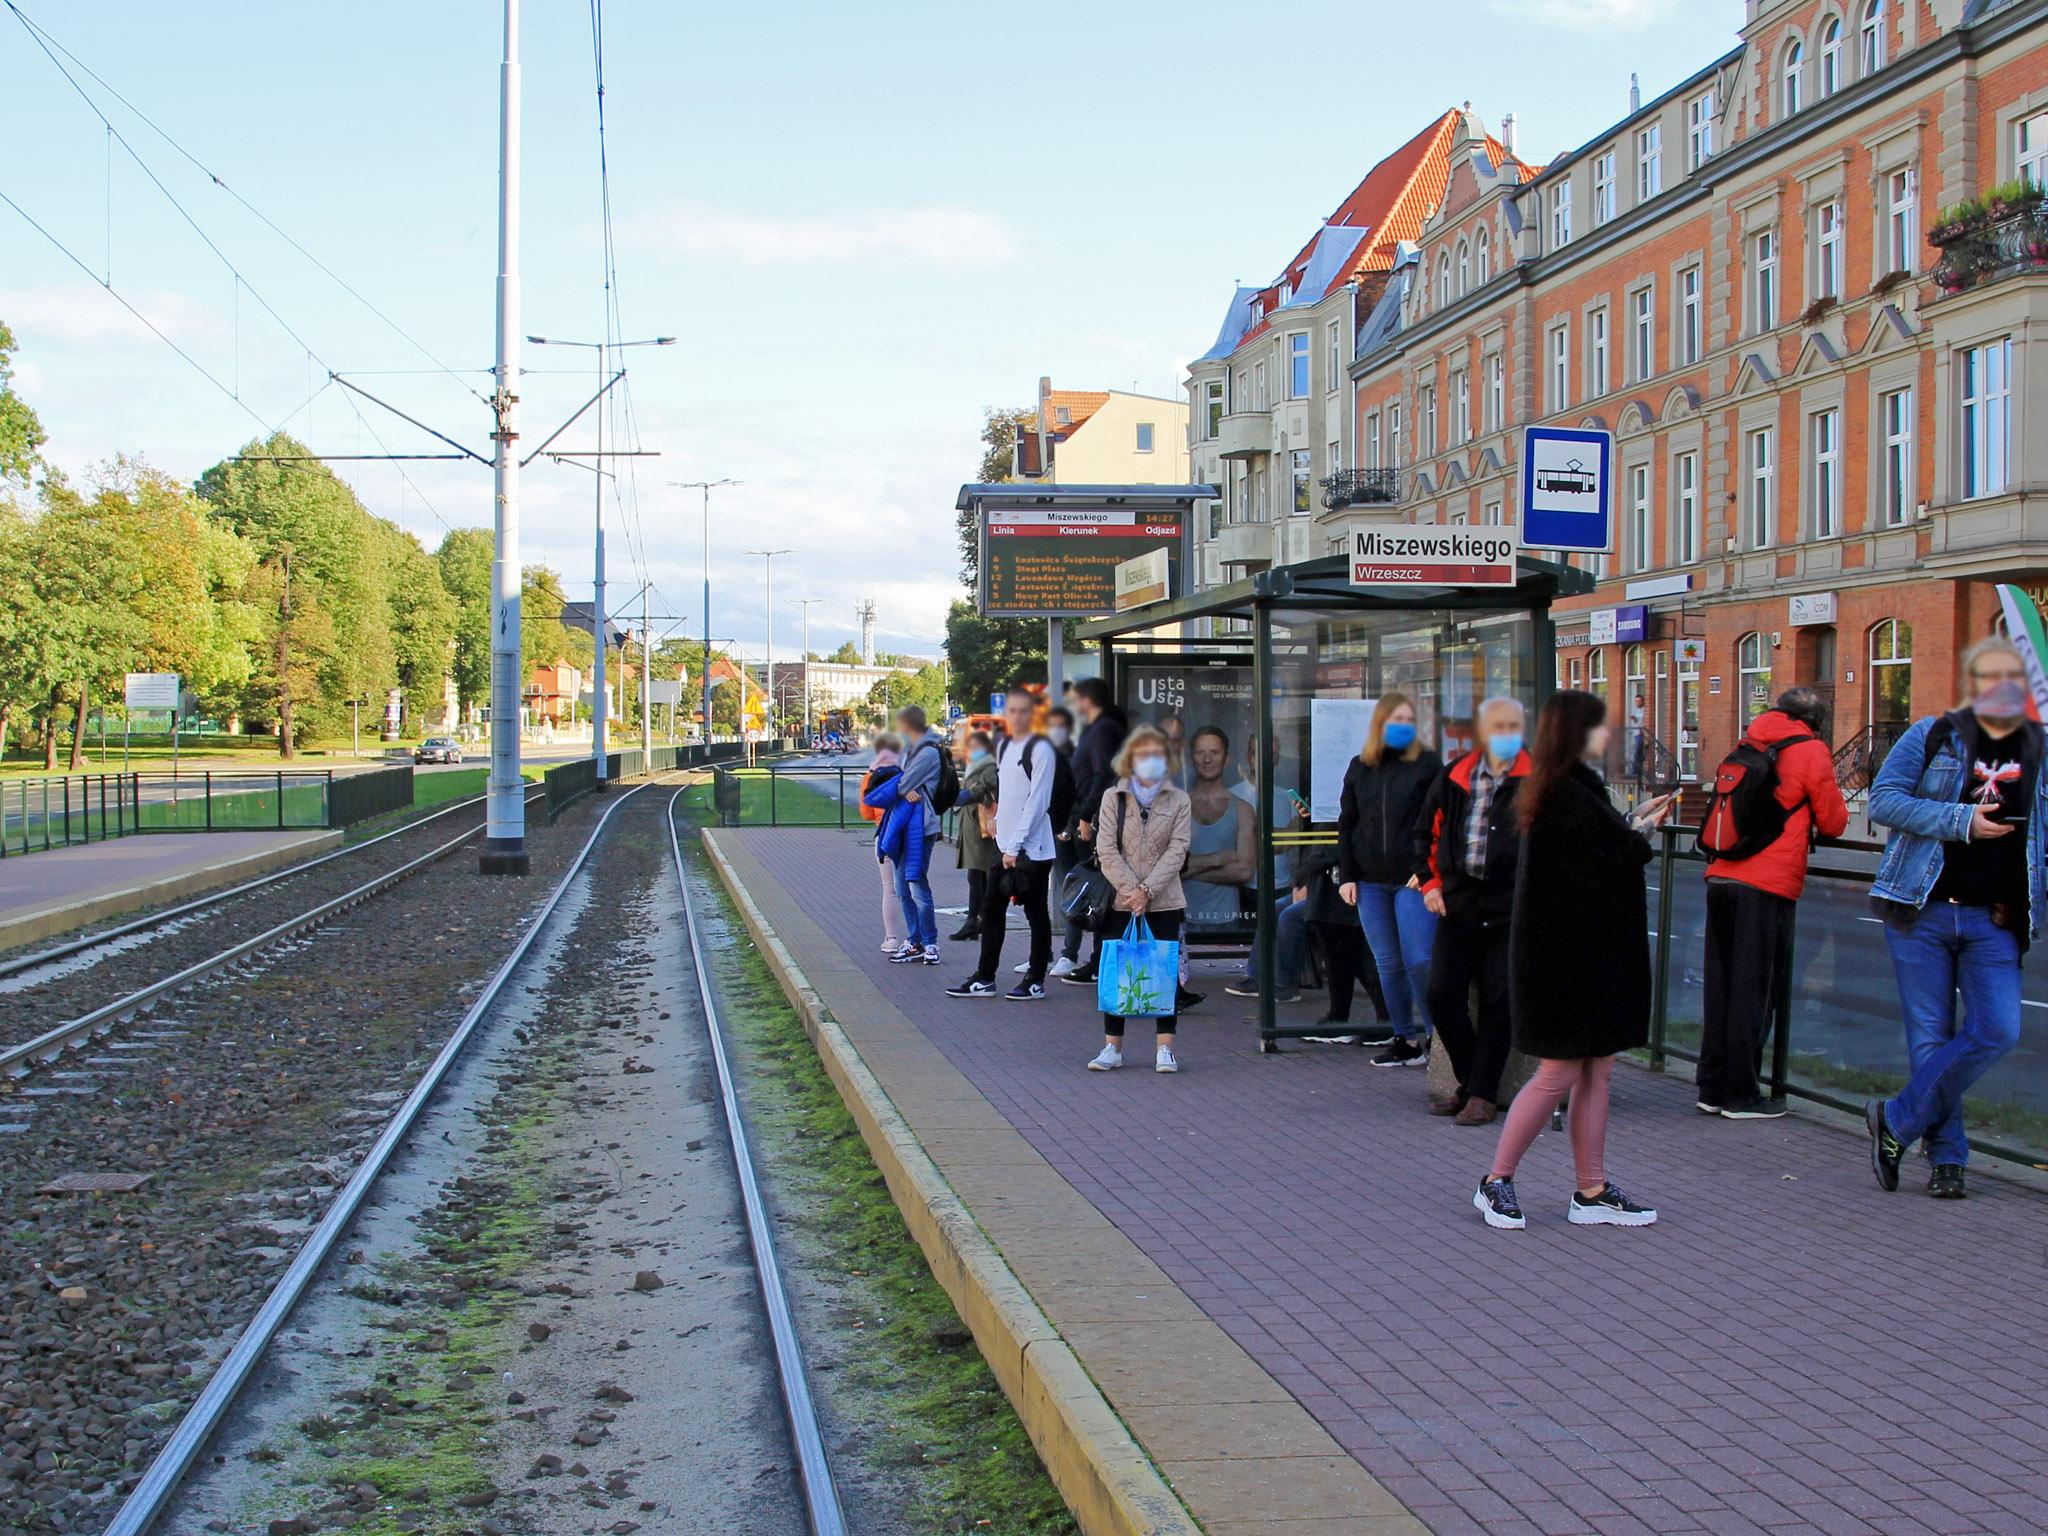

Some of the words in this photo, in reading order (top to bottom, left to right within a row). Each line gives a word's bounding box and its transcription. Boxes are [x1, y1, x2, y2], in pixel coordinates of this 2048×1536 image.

[1047, 513, 1108, 522] Miszewskiego
[1146, 514, 1174, 522] 14:27
[993, 526, 1015, 534] Linia
[1060, 526, 1098, 534] Kierunek
[1146, 526, 1176, 536] Odjazd
[1356, 533, 1511, 562] Miszewskiego
[1357, 566, 1422, 580] Wrzeszcz
